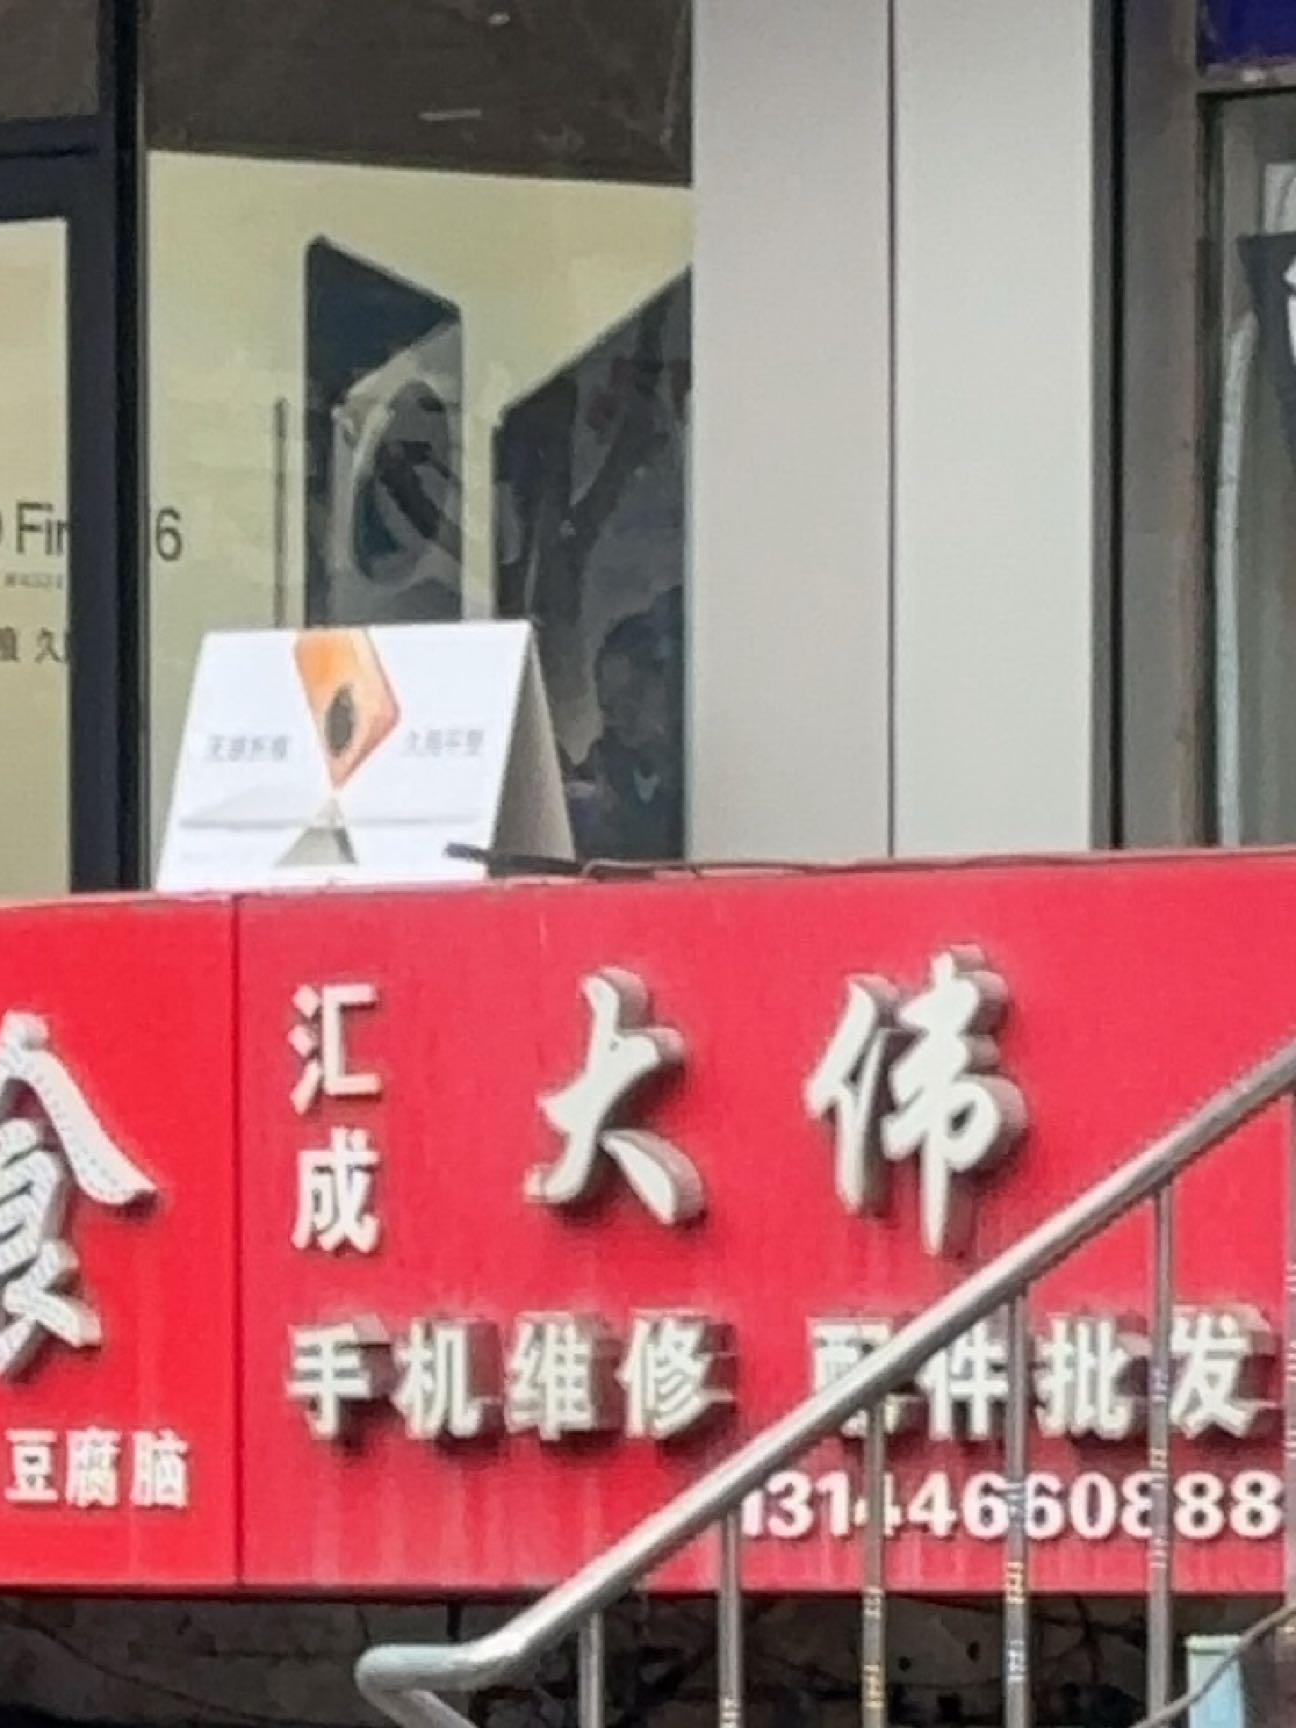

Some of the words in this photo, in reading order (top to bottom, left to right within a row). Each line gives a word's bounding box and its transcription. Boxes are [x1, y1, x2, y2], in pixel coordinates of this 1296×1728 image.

[288, 982, 382, 1254] 汇成
[288, 1312, 734, 1442] 手机维修
[3, 1426, 190, 1508] 豆腐脑
